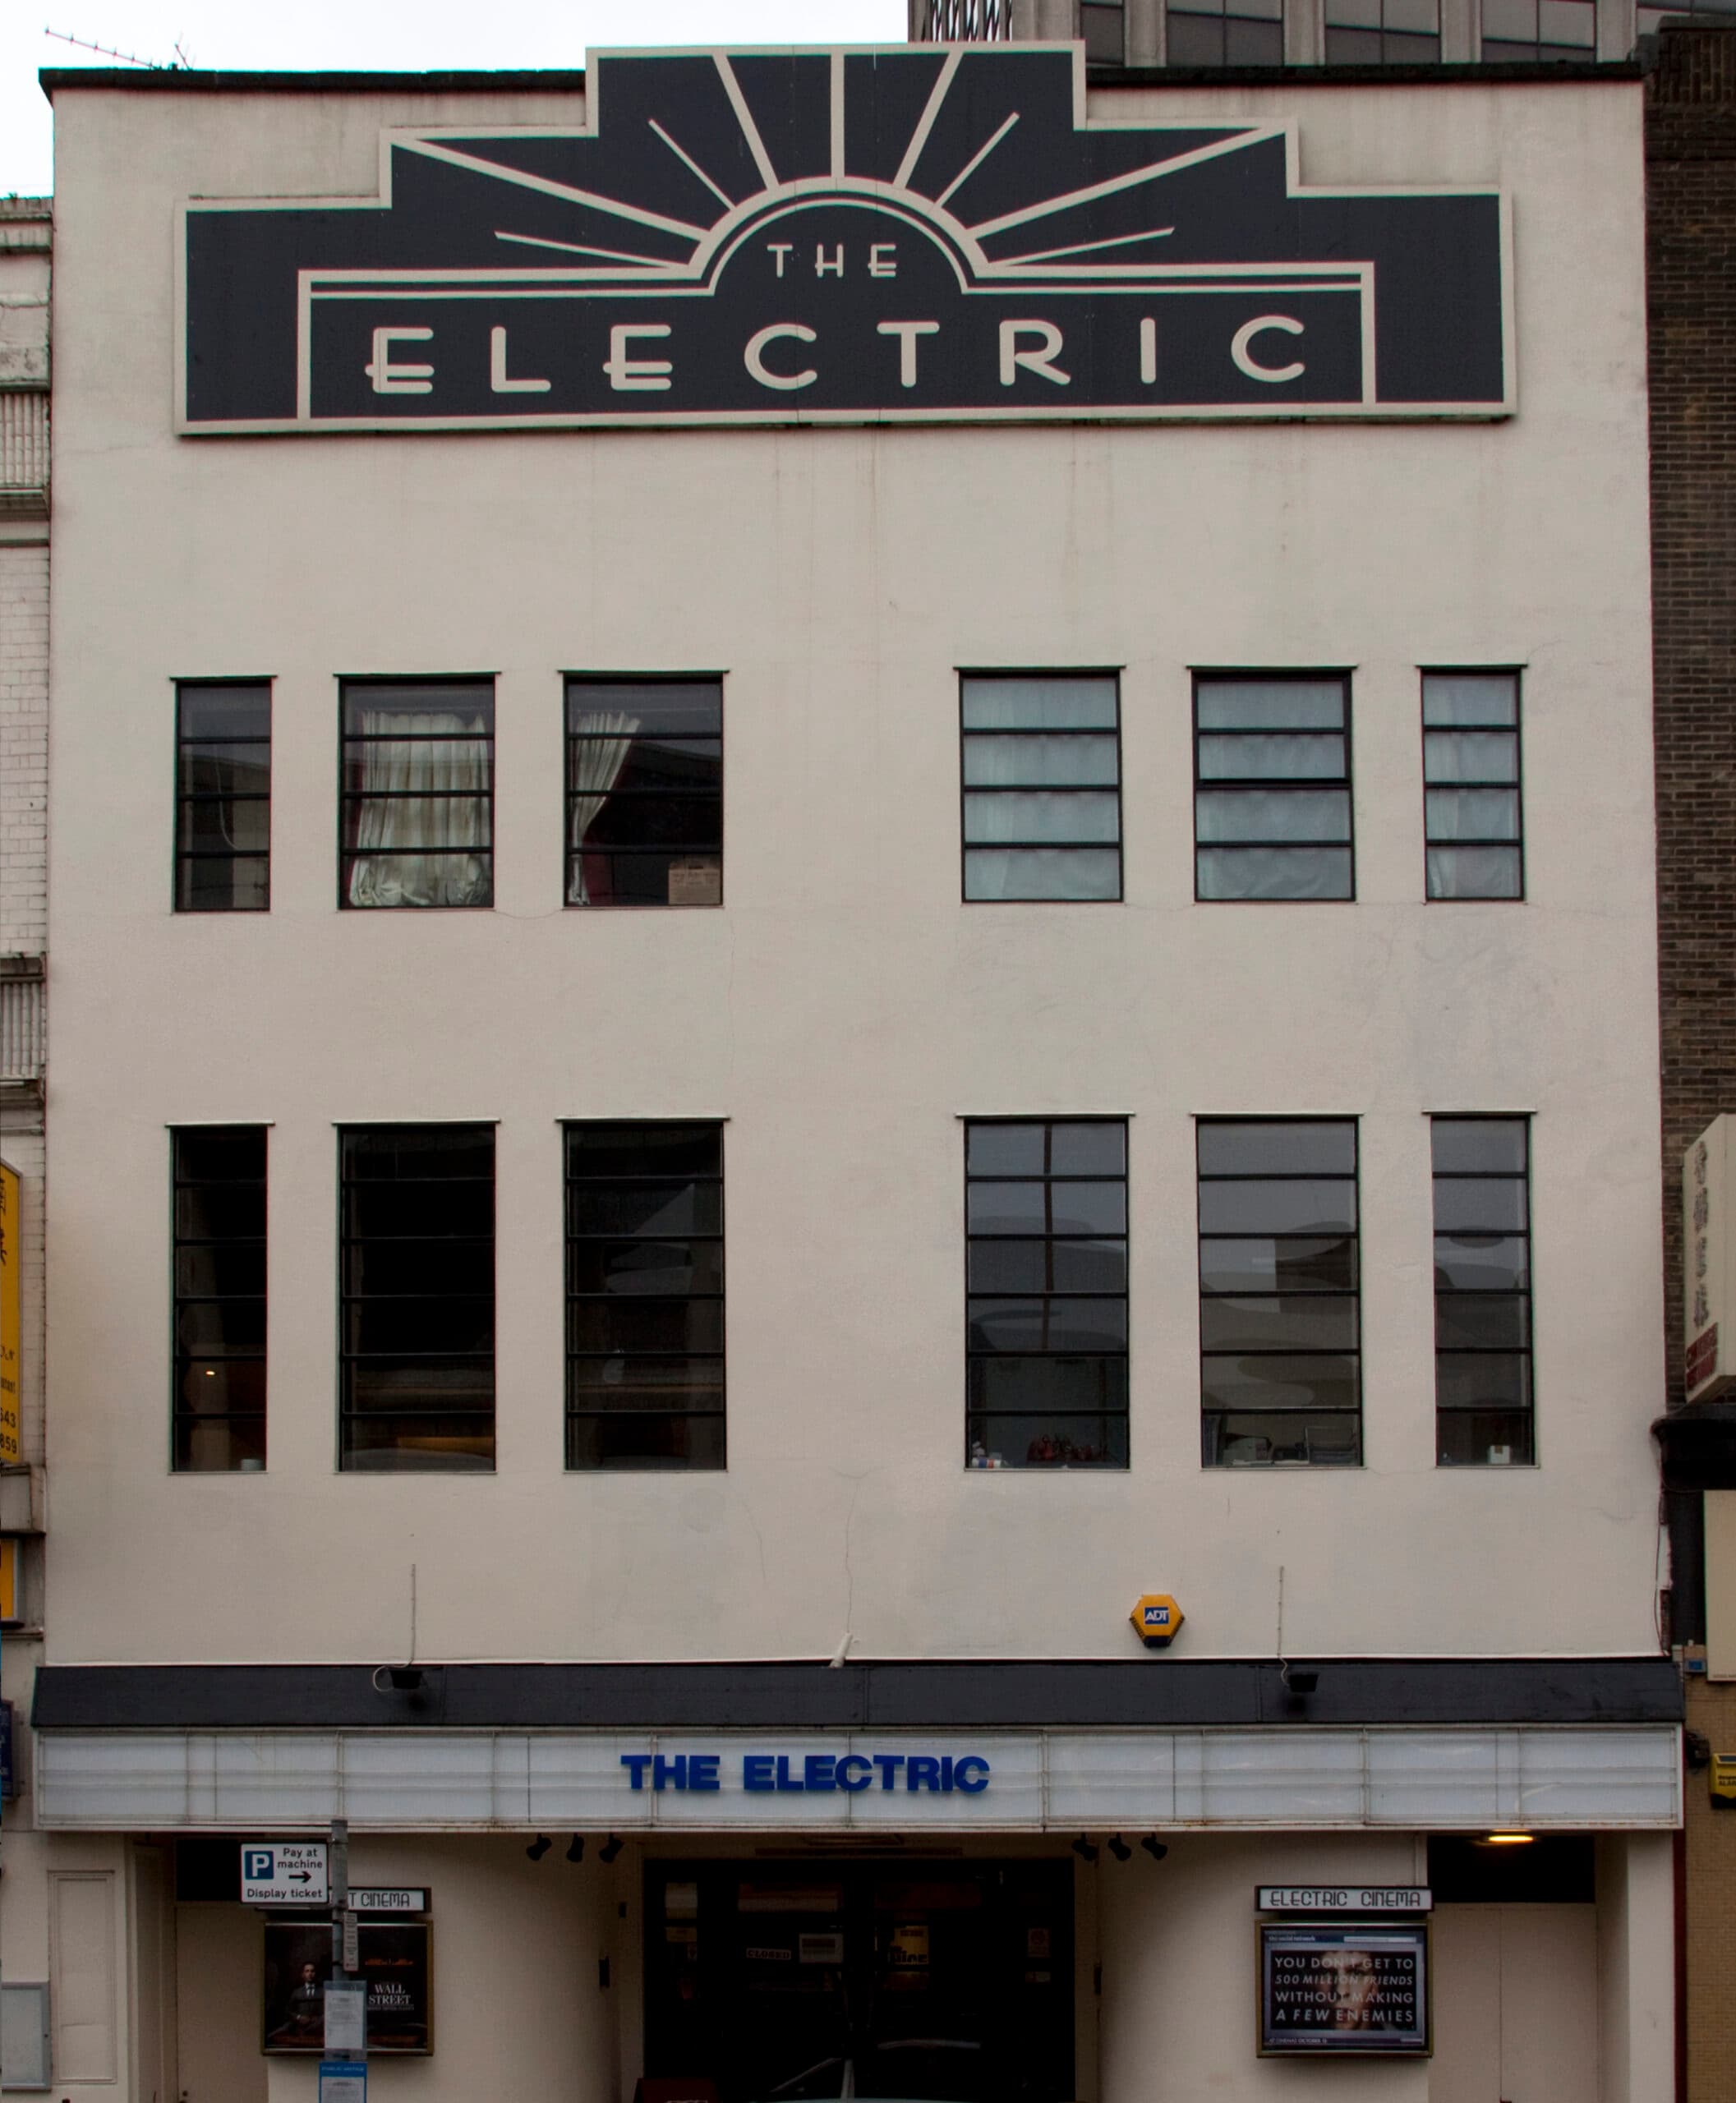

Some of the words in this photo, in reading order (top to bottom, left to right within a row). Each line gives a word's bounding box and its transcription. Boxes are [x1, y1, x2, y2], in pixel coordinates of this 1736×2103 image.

[767, 243, 896, 278] THE
[365, 315, 1305, 393] ELECTRIC
[1145, 1610, 1169, 1621] ADT
[620, 1755, 720, 1791] THE
[744, 1755, 990, 1793] ELECTRIC
[283, 1848, 302, 1858] Pay
[306, 1848, 318, 1857] at
[252, 1853, 270, 1878] P
[277, 1859, 323, 1868] machine
[247, 1888, 287, 1899] Display
[291, 1889, 323, 1898] ticket
[1269, 1891, 1347, 1907] ELECTRIC
[1361, 1891, 1421, 1907] CINEMA
[361, 1892, 411, 1907] CINEMA
[748, 1950, 790, 1959] CLOSED
[1275, 1958, 1305, 1968] YOU
[1362, 1958, 1391, 1969] GET
[1395, 1958, 1414, 1969] TO
[1274, 1975, 1300, 1985] 500
[1303, 1975, 1359, 1985] MILLION
[1364, 1976, 1413, 1986] FRIENDS
[375, 1984, 406, 1995] WALL
[368, 1995, 412, 2005] STREET
[1275, 1991, 1346, 2003] WITHOUT
[1353, 1992, 1414, 2003] MAKING
[1275, 2009, 1286, 2021] A
[1293, 2009, 1330, 2021] FEW
[1335, 2009, 1414, 2022] ENEMIES
